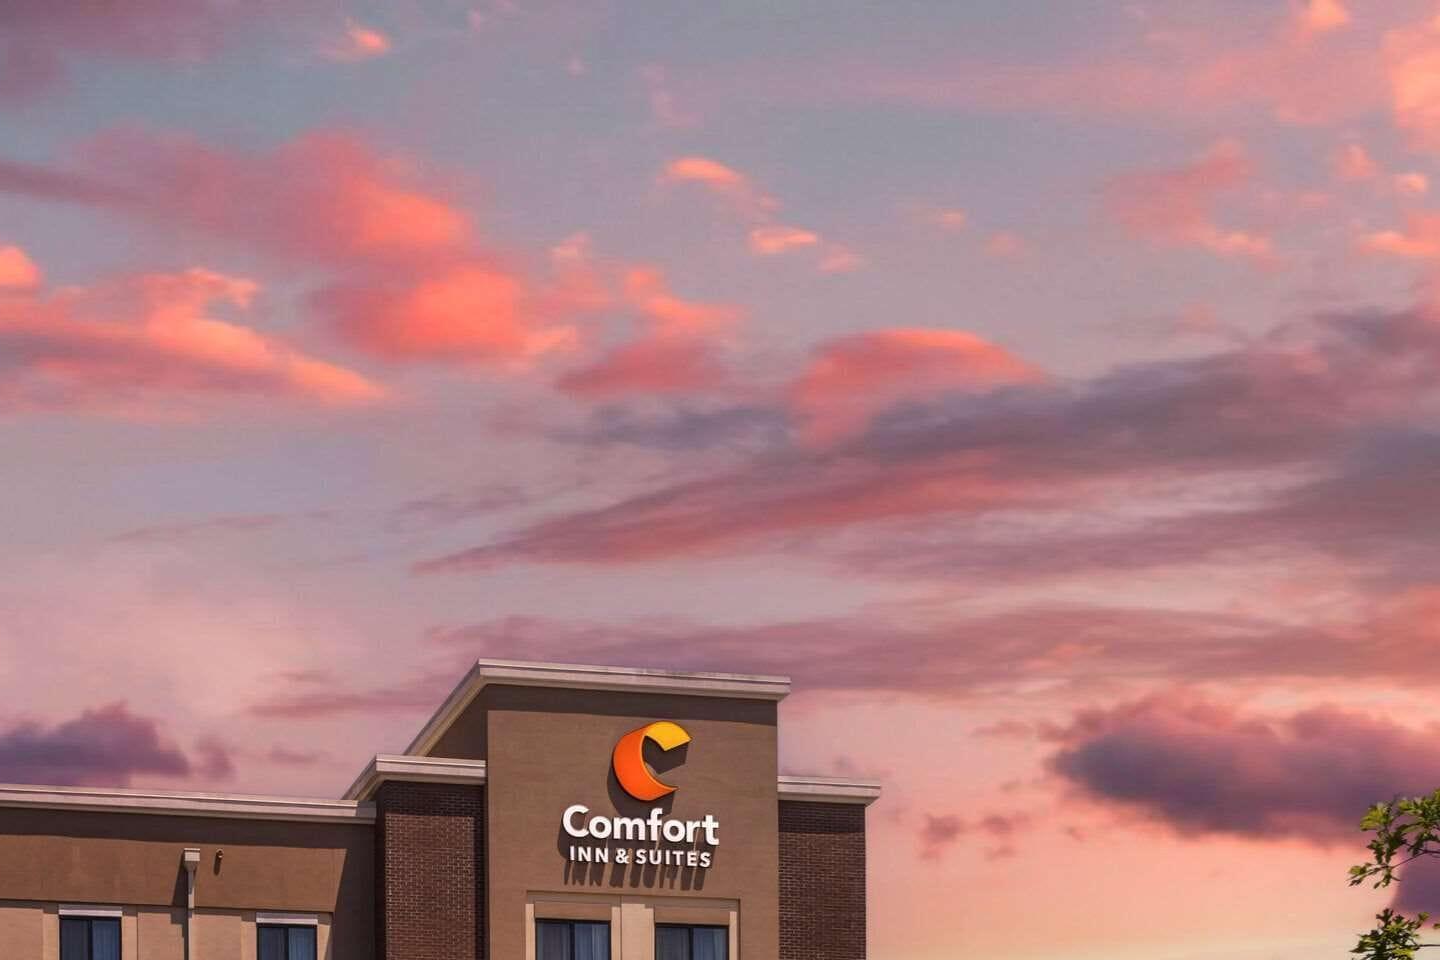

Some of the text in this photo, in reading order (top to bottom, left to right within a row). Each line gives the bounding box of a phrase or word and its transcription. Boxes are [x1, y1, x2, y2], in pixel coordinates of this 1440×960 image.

[562, 804, 720, 846] Comfort
[569, 845, 711, 868] INN & SUITES
